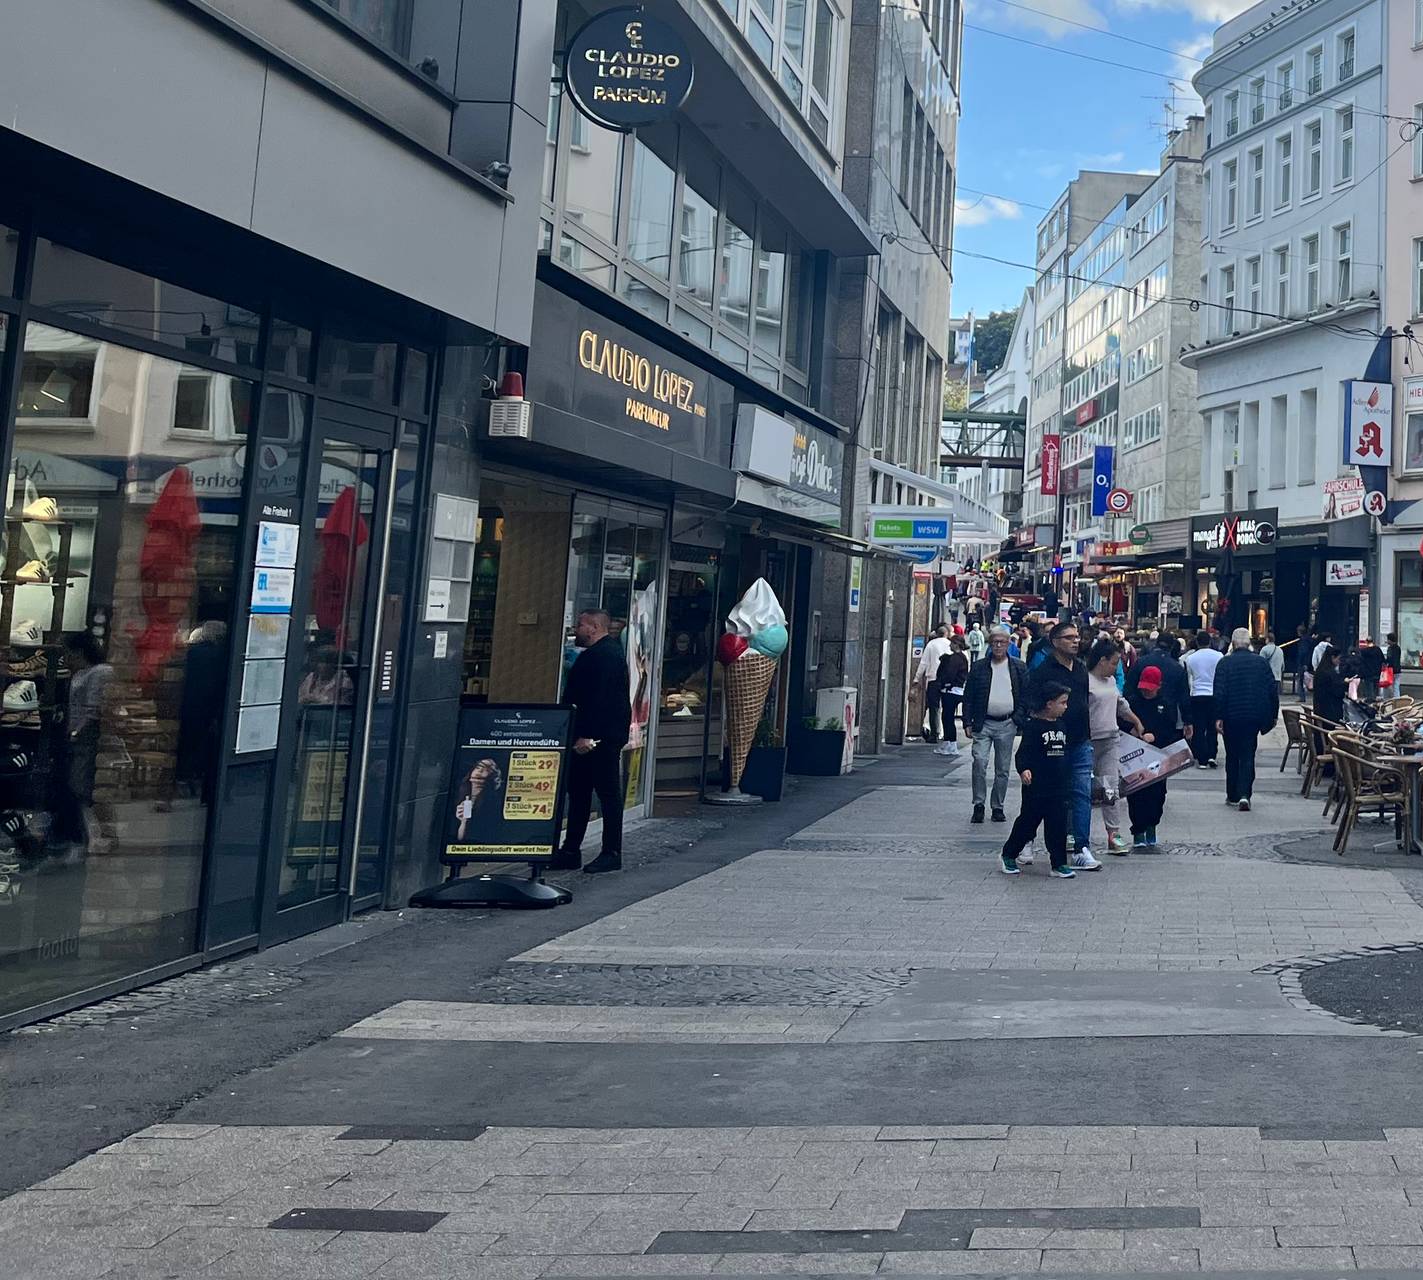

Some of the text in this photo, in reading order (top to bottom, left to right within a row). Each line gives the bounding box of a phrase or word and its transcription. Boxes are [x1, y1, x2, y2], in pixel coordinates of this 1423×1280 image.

[584, 49, 680, 67] CLAUDIO
[598, 64, 665, 81] LOPEZ
[579, 329, 651, 393] CLAUDIO
[653, 364, 695, 414] LOPEZ
[625, 397, 671, 431] PARFUMEUR
[1323, 477, 1364, 493] FAHRSCHULE
[512, 738, 560, 746] Herrendüfte
[538, 760, 553, 770] 29
[535, 781, 550, 791] 49
[532, 804, 547, 814] 74
[467, 846, 512, 855] Lieblingsduft
